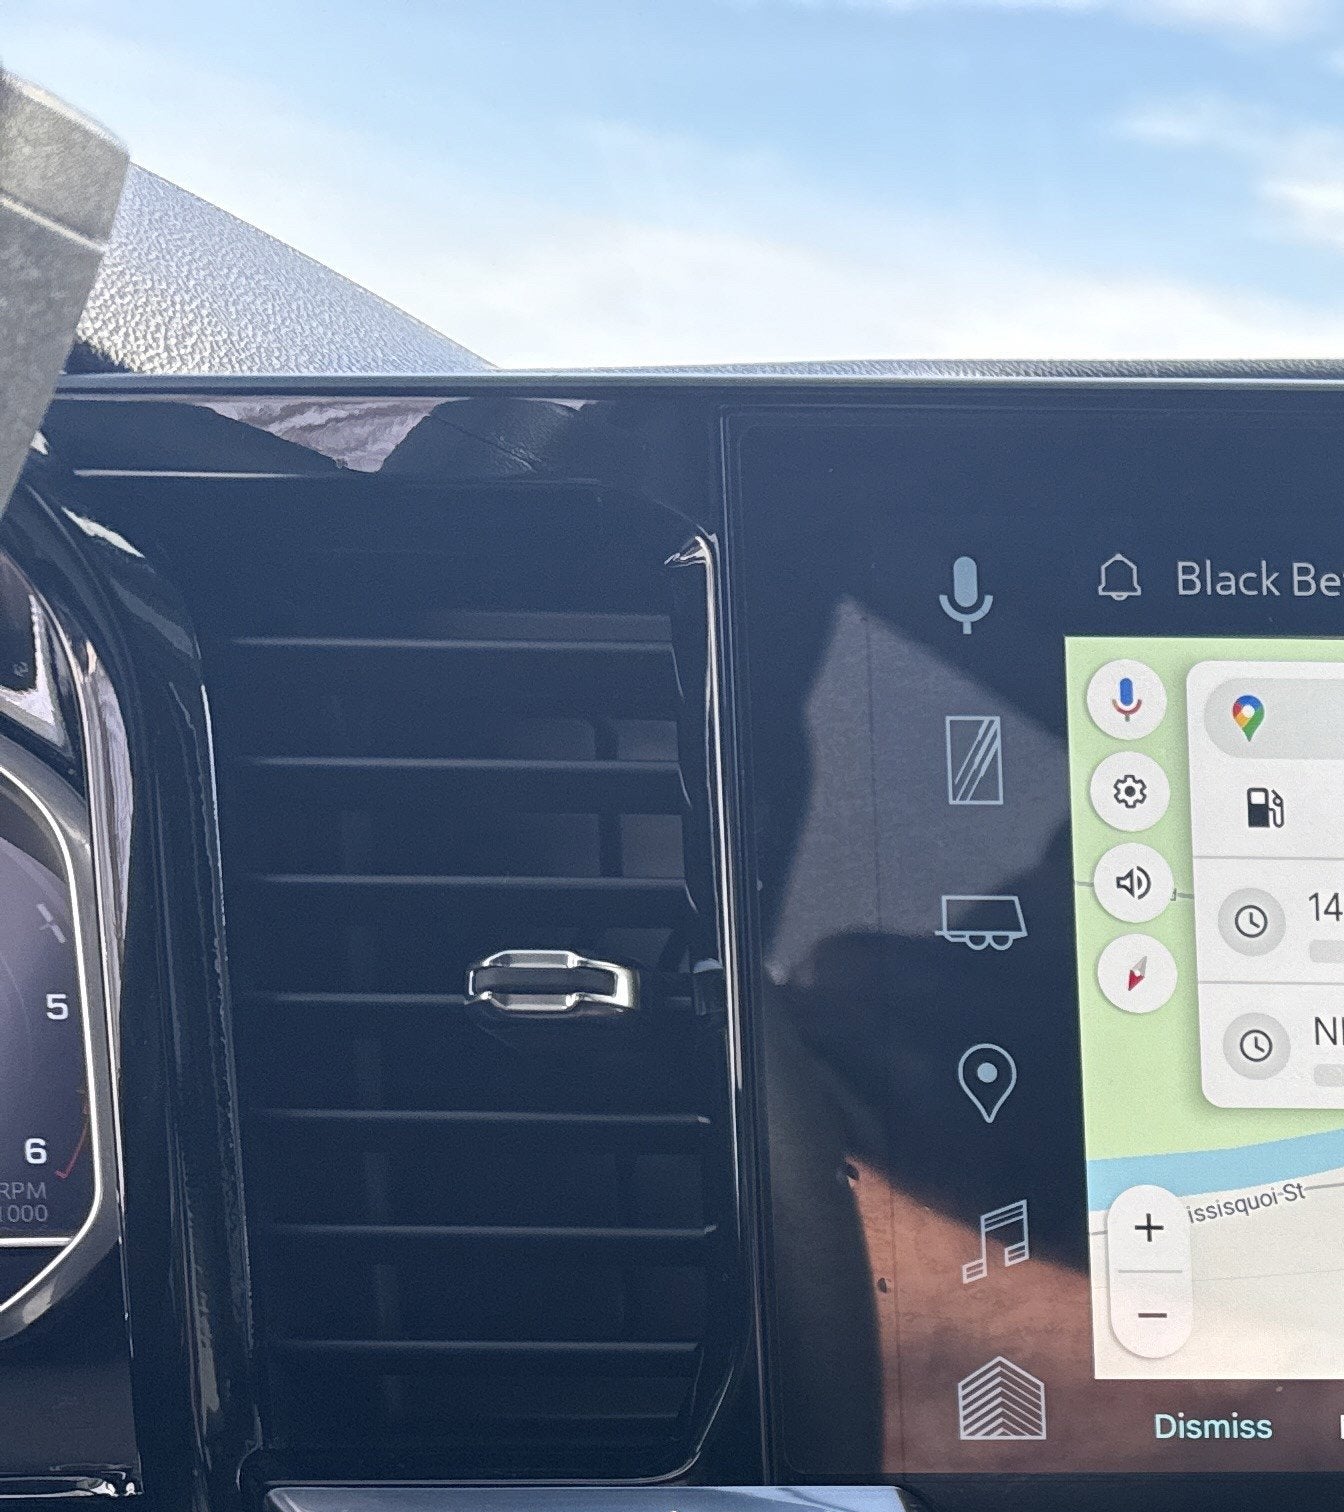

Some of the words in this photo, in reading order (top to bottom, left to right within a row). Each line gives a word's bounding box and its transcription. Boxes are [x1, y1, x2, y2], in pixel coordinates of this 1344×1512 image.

[1177, 559, 1281, 596] Black
[1309, 892, 1344, 922] 14
[45, 993, 69, 1020] 5
[24, 1137, 48, 1165] 6
[1282, 1182, 1306, 1202] St
[1155, 1412, 1273, 1439] Dismiss
